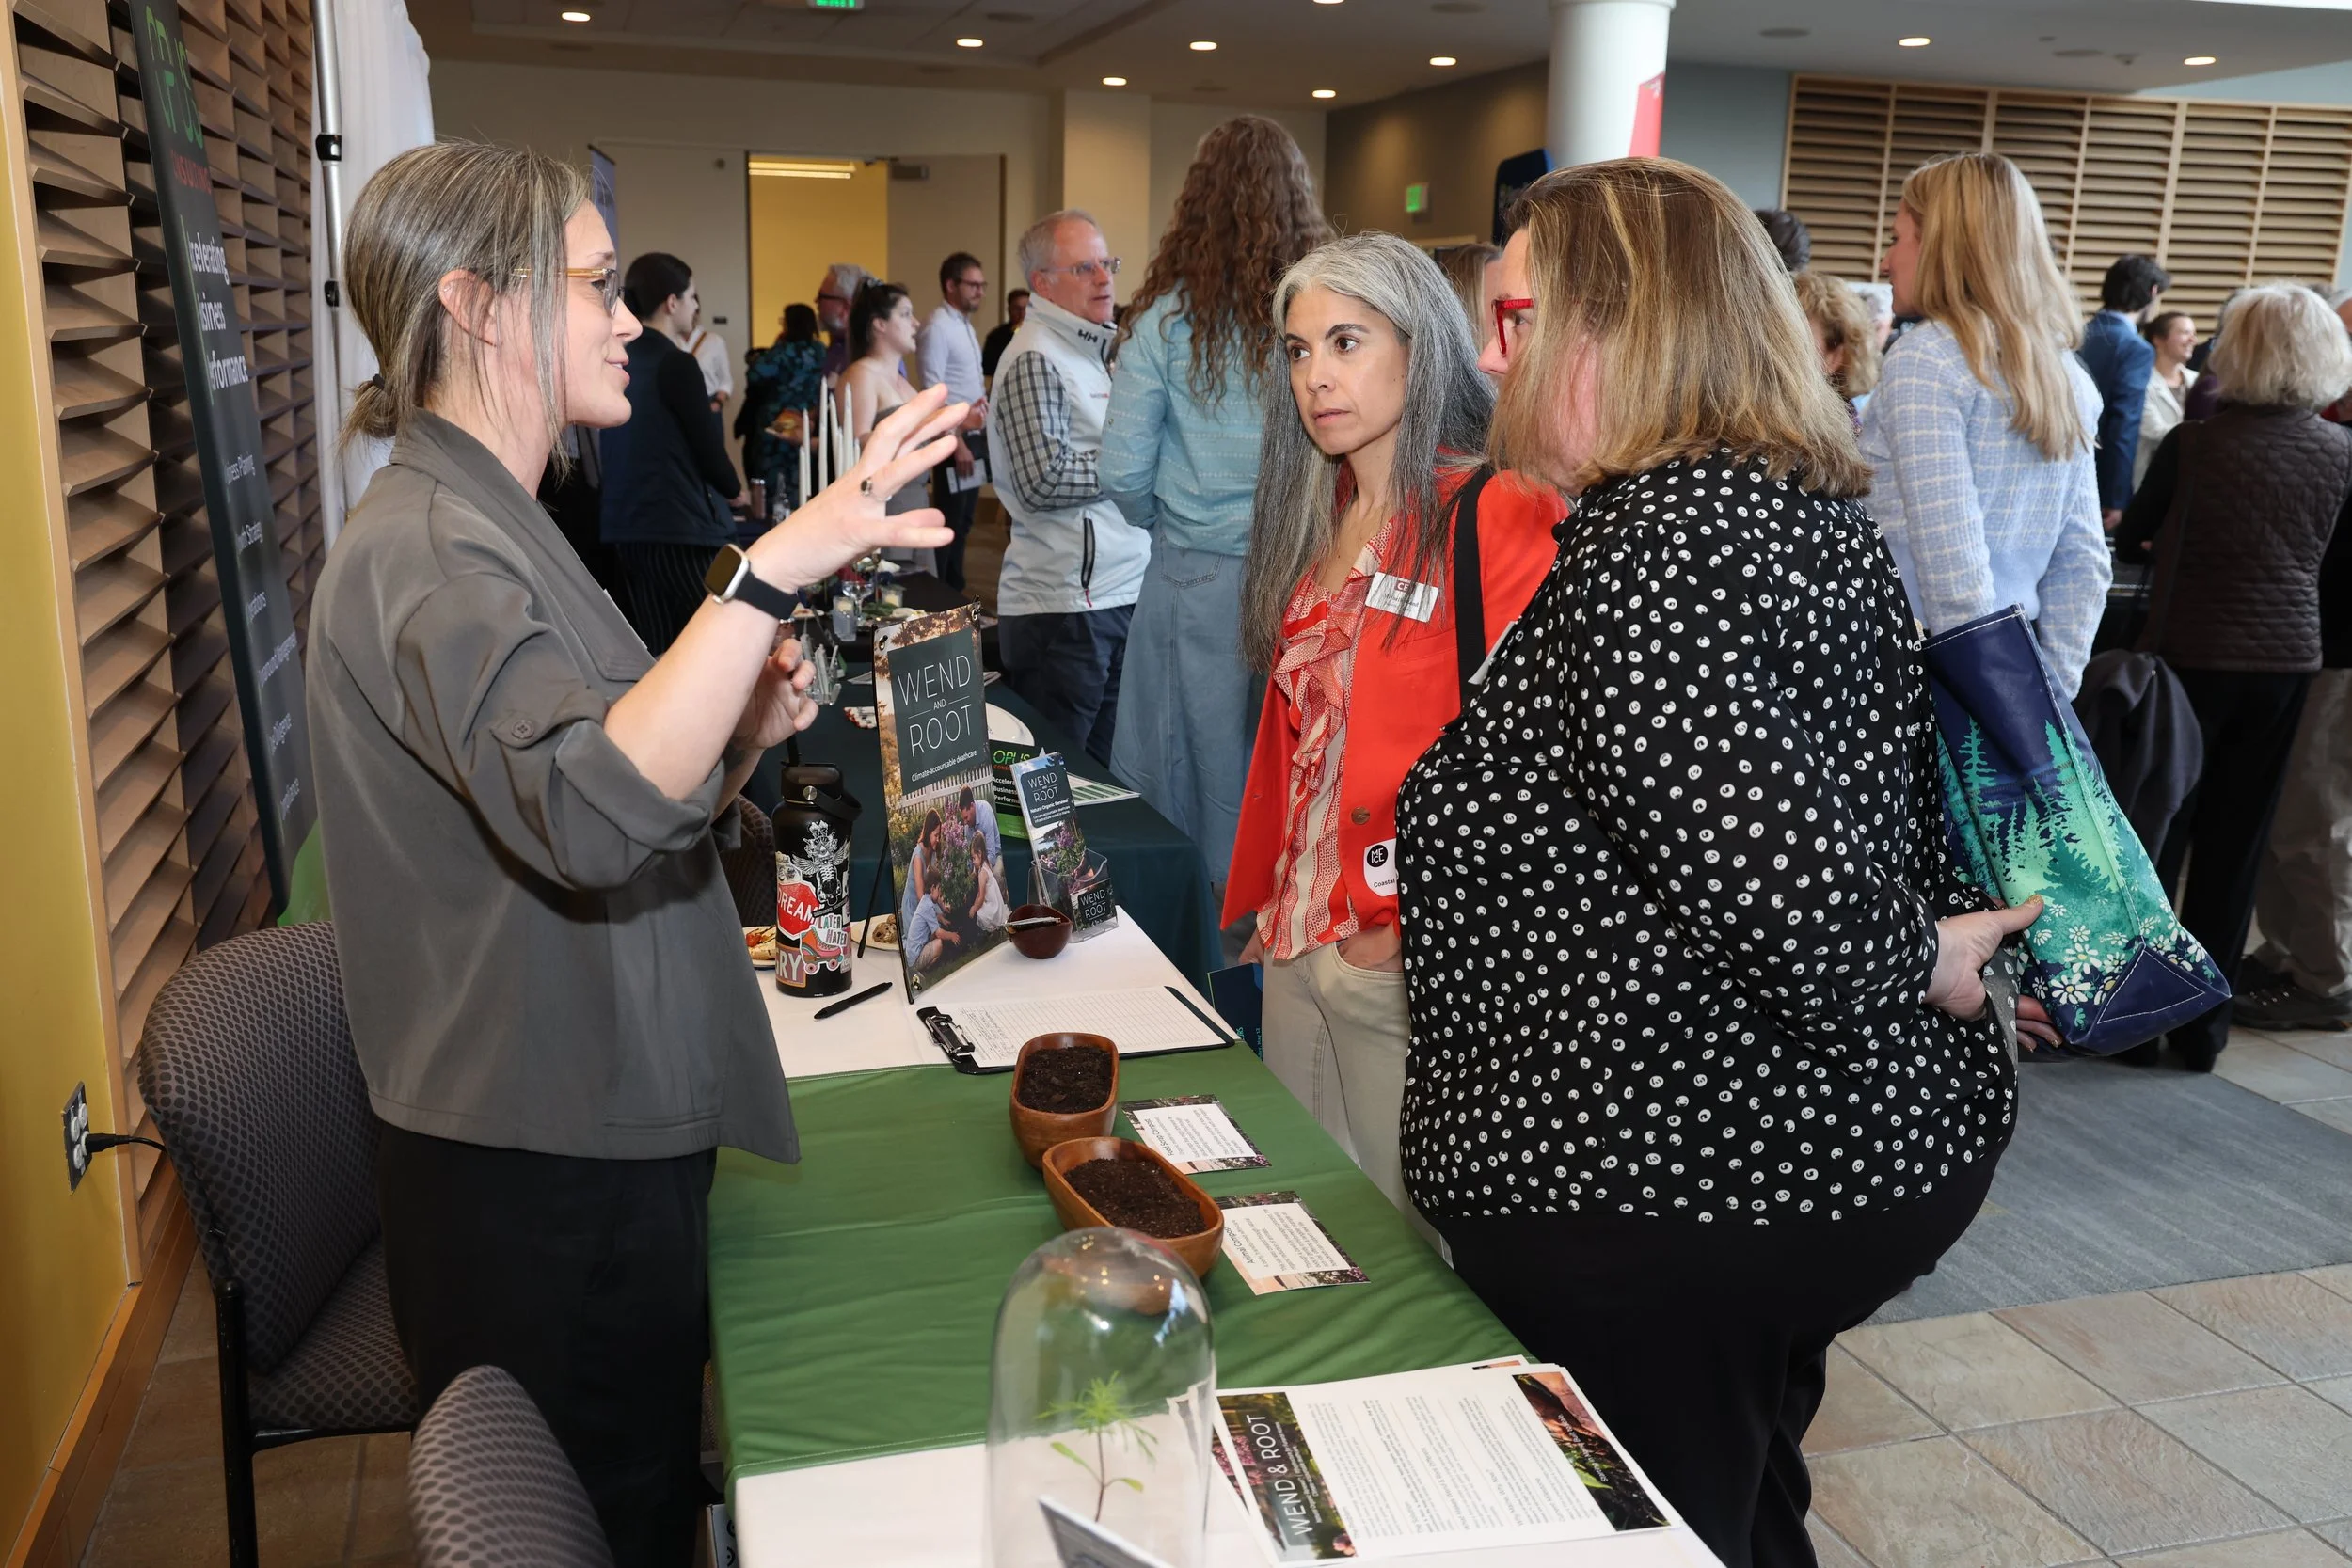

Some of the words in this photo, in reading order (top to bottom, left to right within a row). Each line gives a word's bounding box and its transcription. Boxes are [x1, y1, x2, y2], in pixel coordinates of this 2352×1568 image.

[1078, 328, 1098, 343] HH
[1397, 582, 1410, 592] CE
[898, 655, 971, 705] WEND
[933, 698, 946, 710] AND
[909, 704, 972, 757] ROOT
[911, 758, 956, 783] Climate-accountable
[1027, 772, 1057, 788] WEND
[1033, 786, 1059, 803] ROOT
[1374, 878, 1396, 888] Coastal
[777, 886, 818, 926] DREAM
[1080, 889, 1105, 906] WEND
[1084, 901, 1106, 919] ROOT
[818, 914, 841, 929] LATER
[776, 948, 802, 981] RY
[1225, 1226, 1242, 1247] Compost
[1247, 1414, 1281, 1460] ROOT
[1268, 1464, 1288, 1474] &
[1274, 1479, 1313, 1536] WEND
